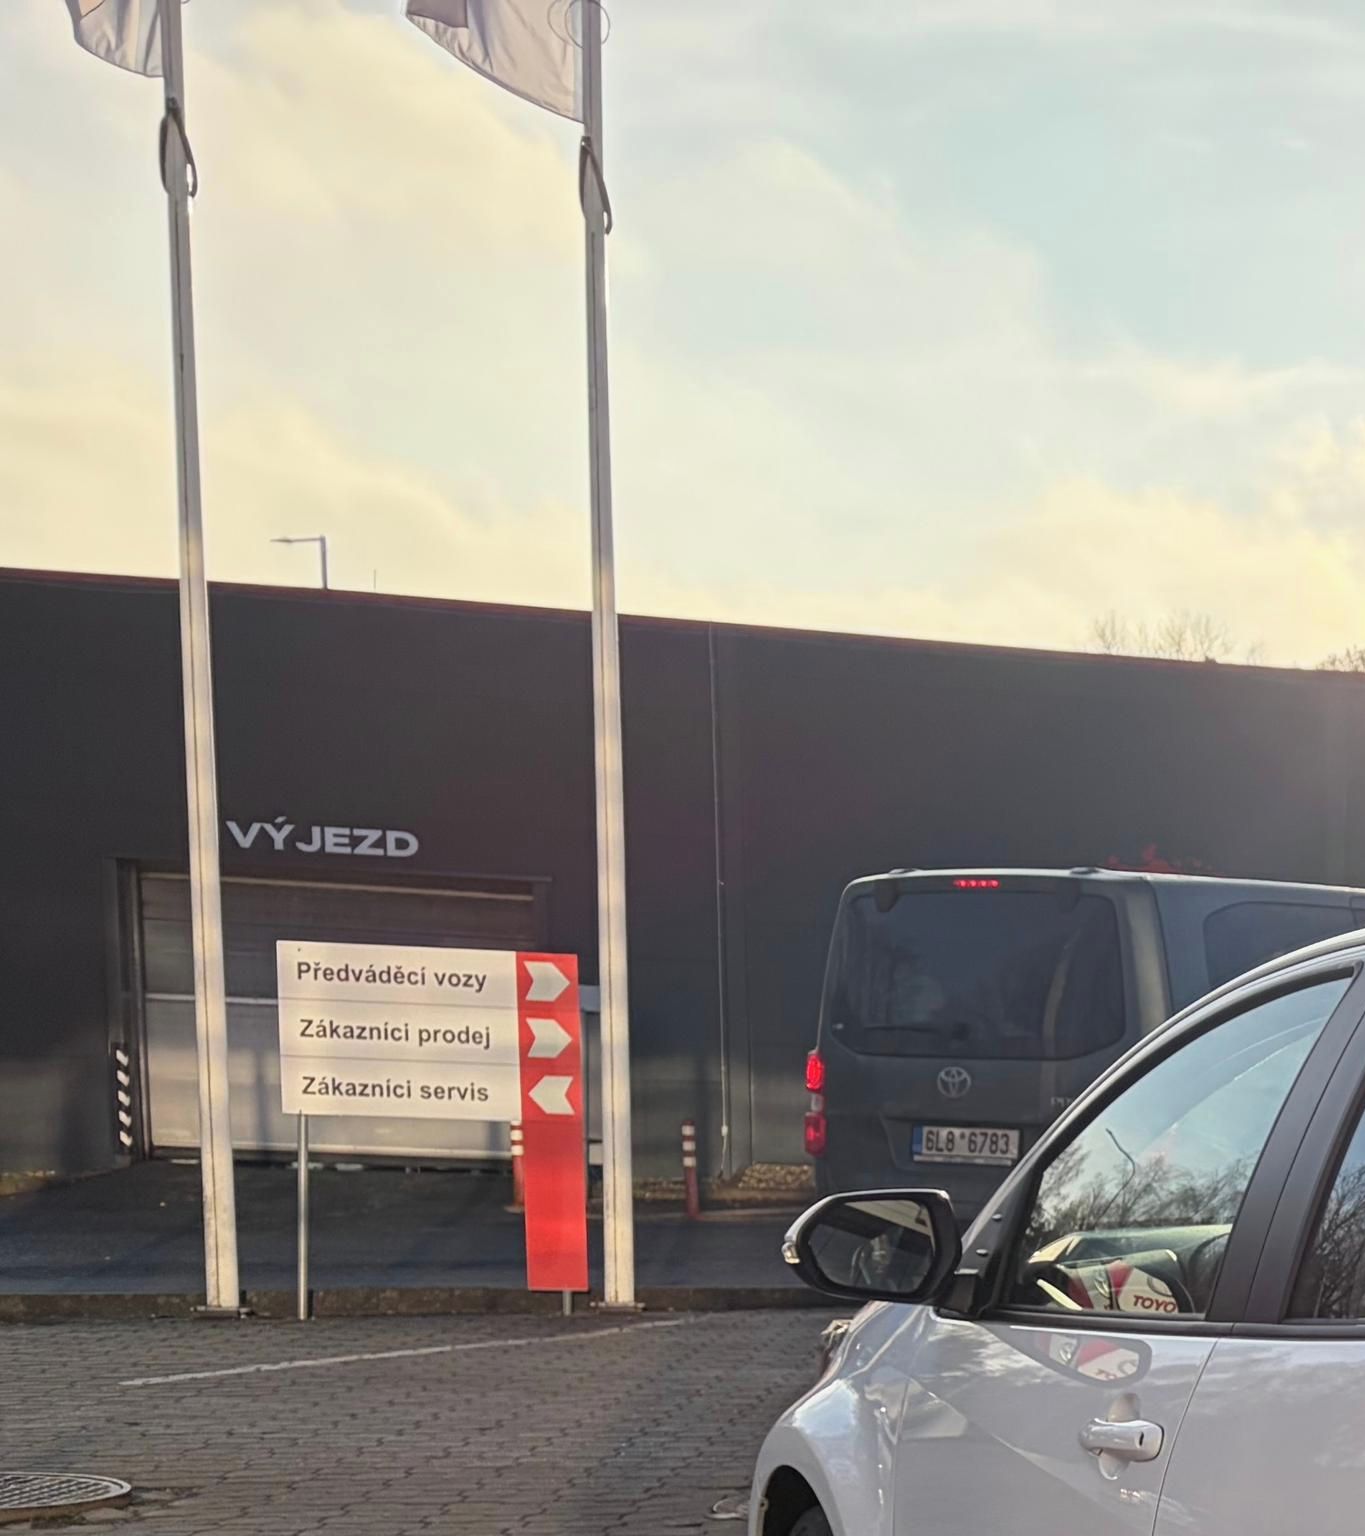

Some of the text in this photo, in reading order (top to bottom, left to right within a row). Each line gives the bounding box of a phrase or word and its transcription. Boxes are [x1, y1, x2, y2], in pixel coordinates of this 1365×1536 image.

[226, 816, 419, 858] VÝJEZD
[296, 961, 487, 992] Předváděcí vozy
[299, 1018, 491, 1050] Zákazníci prodej
[302, 1076, 489, 1102] Zákazníci servis
[925, 1130, 1010, 1154] 6L8 6783
